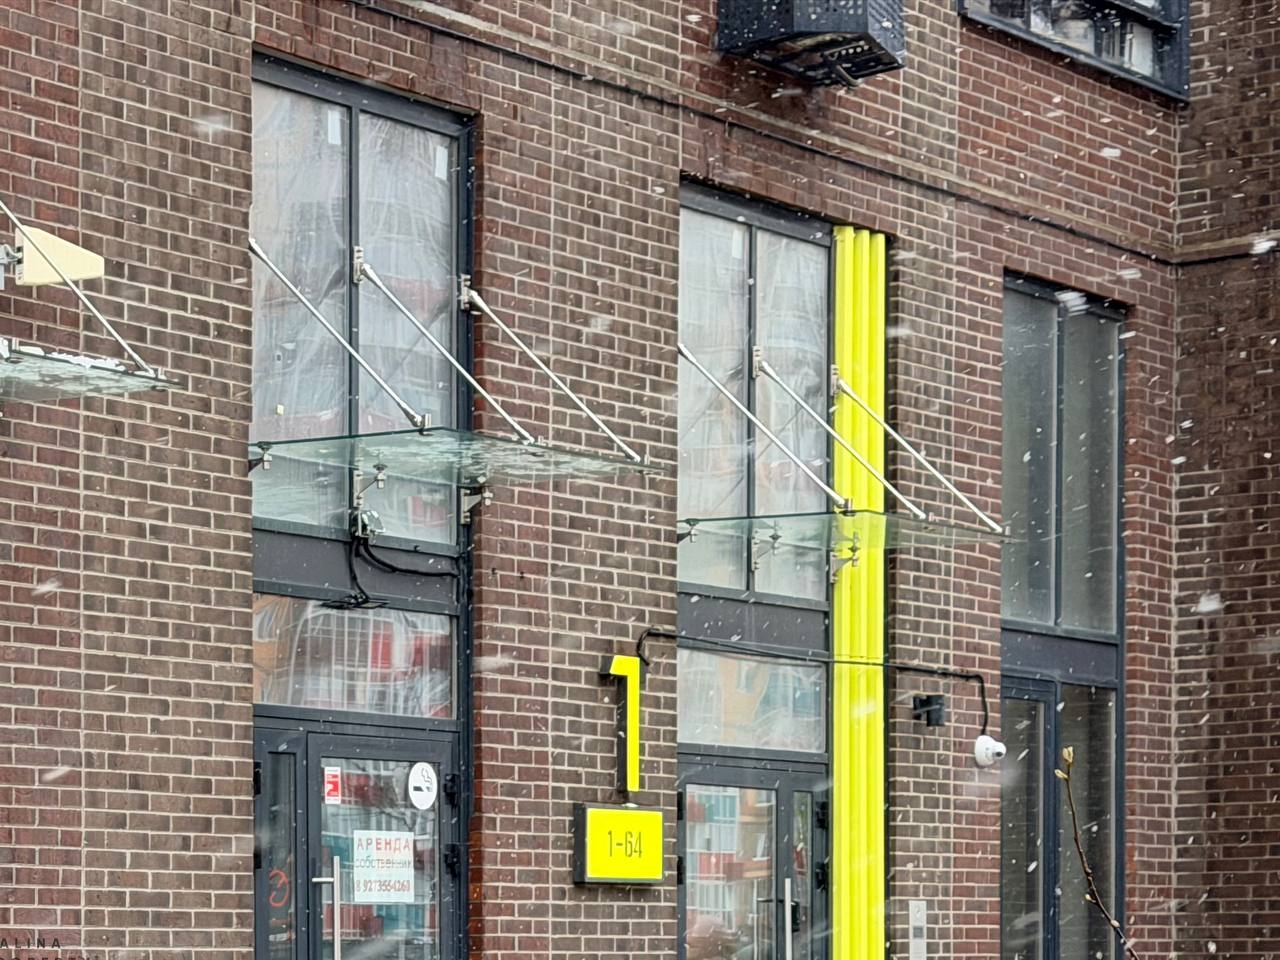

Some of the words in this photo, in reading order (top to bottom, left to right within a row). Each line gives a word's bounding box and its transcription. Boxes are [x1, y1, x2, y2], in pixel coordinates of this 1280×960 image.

[609, 654, 640, 792] 1
[357, 837, 411, 854] АРЕНДА
[607, 829, 643, 859] 1-64
